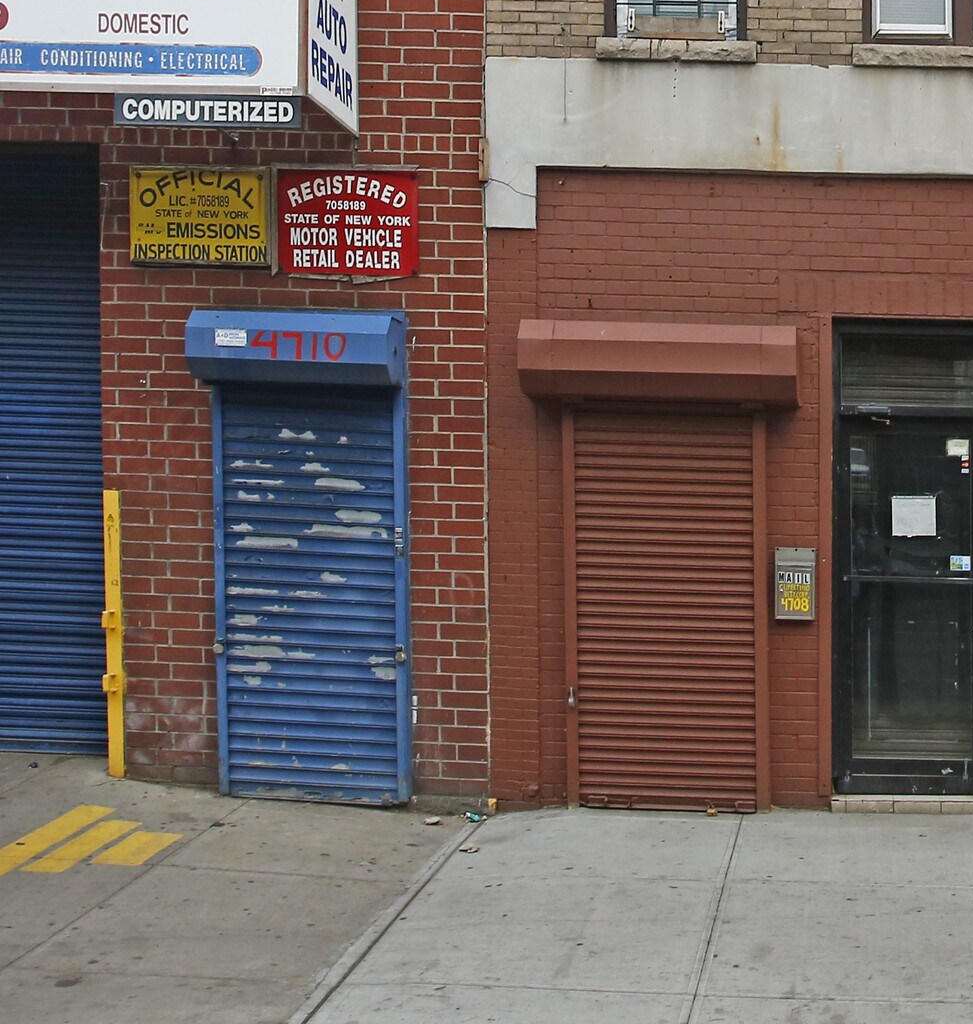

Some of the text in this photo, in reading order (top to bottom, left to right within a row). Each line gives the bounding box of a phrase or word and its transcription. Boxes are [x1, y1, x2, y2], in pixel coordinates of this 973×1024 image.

[98, 12, 189, 35] DOMESTIC
[0, 48, 247, 71] AIR CONDITIONING ELECTRICAL
[311, 38, 354, 112] REPAIR
[121, 98, 294, 123] COMPUTERIZED
[140, 171, 255, 210] OFFICIAL
[169, 195, 189, 207] LIC.
[287, 175, 408, 209] REGISTERED
[155, 208, 182, 218] STATE
[197, 210, 220, 219] NEW
[223, 210, 249, 220] YORK
[325, 200, 367, 211] 7058189
[284, 213, 411, 227] STATE OF NEW YORK
[166, 222, 261, 240] EMISSIONS
[290, 227, 402, 248] MOTOR VEHICLE
[134, 243, 267, 262] INSPECTION STATION
[293, 248, 401, 270] RETAIL DEALER
[250, 330, 347, 362] 4710
[778, 572, 809, 584] MAIL
[781, 597, 810, 612] 4708
